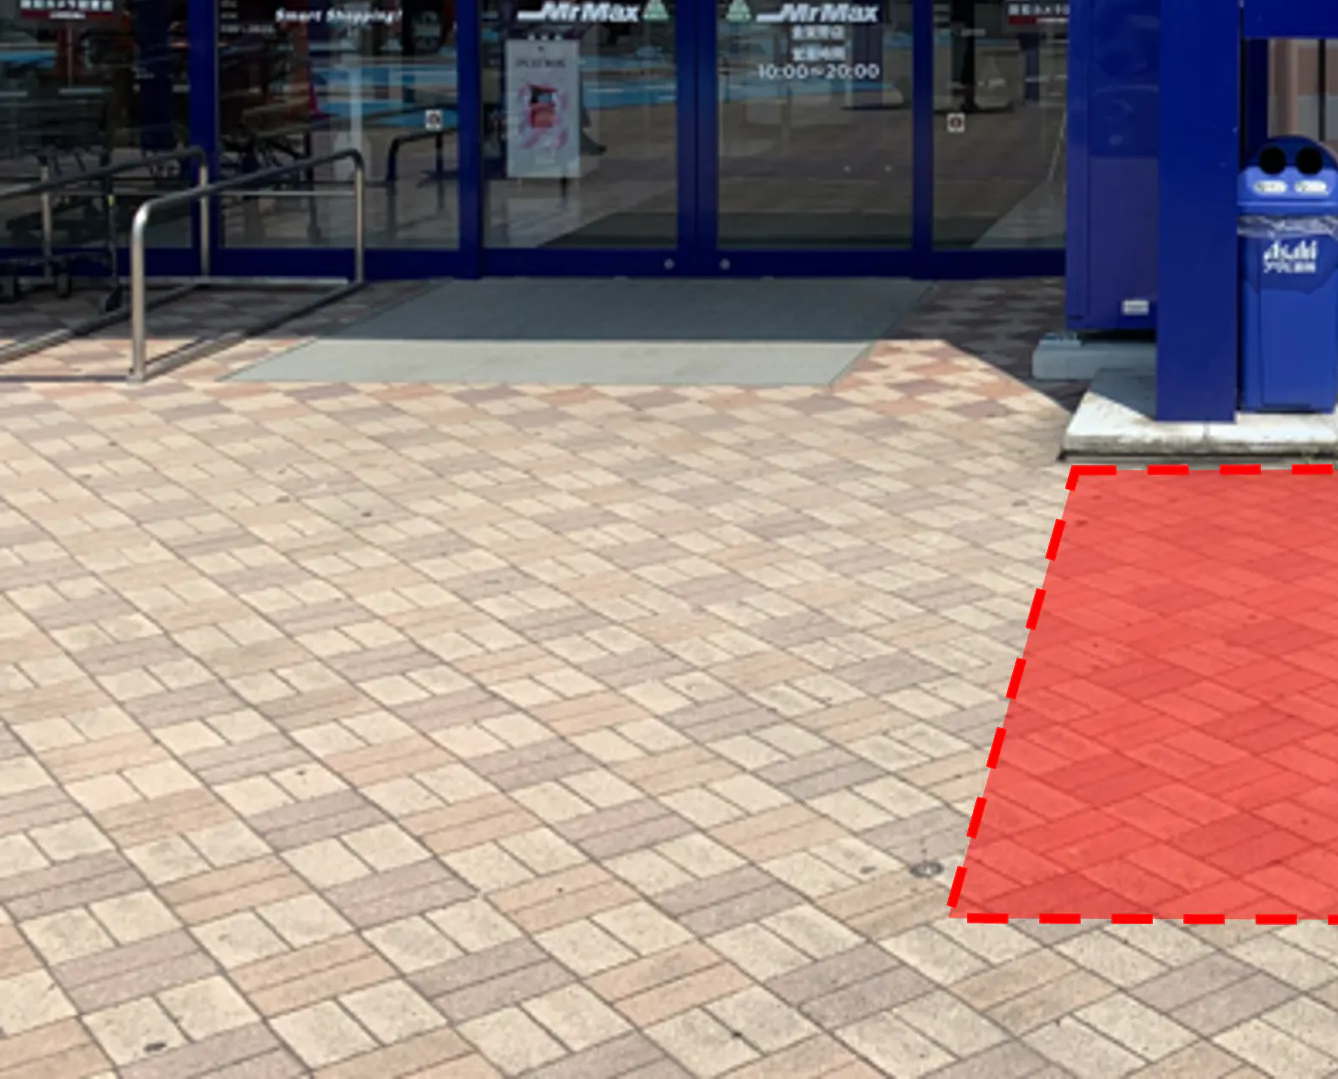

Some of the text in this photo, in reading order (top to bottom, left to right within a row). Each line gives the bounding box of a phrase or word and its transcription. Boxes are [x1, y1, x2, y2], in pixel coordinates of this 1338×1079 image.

[275, 8, 322, 23] Smart
[517, 1, 640, 22] MrMax
[756, 3, 879, 22] MrMax
